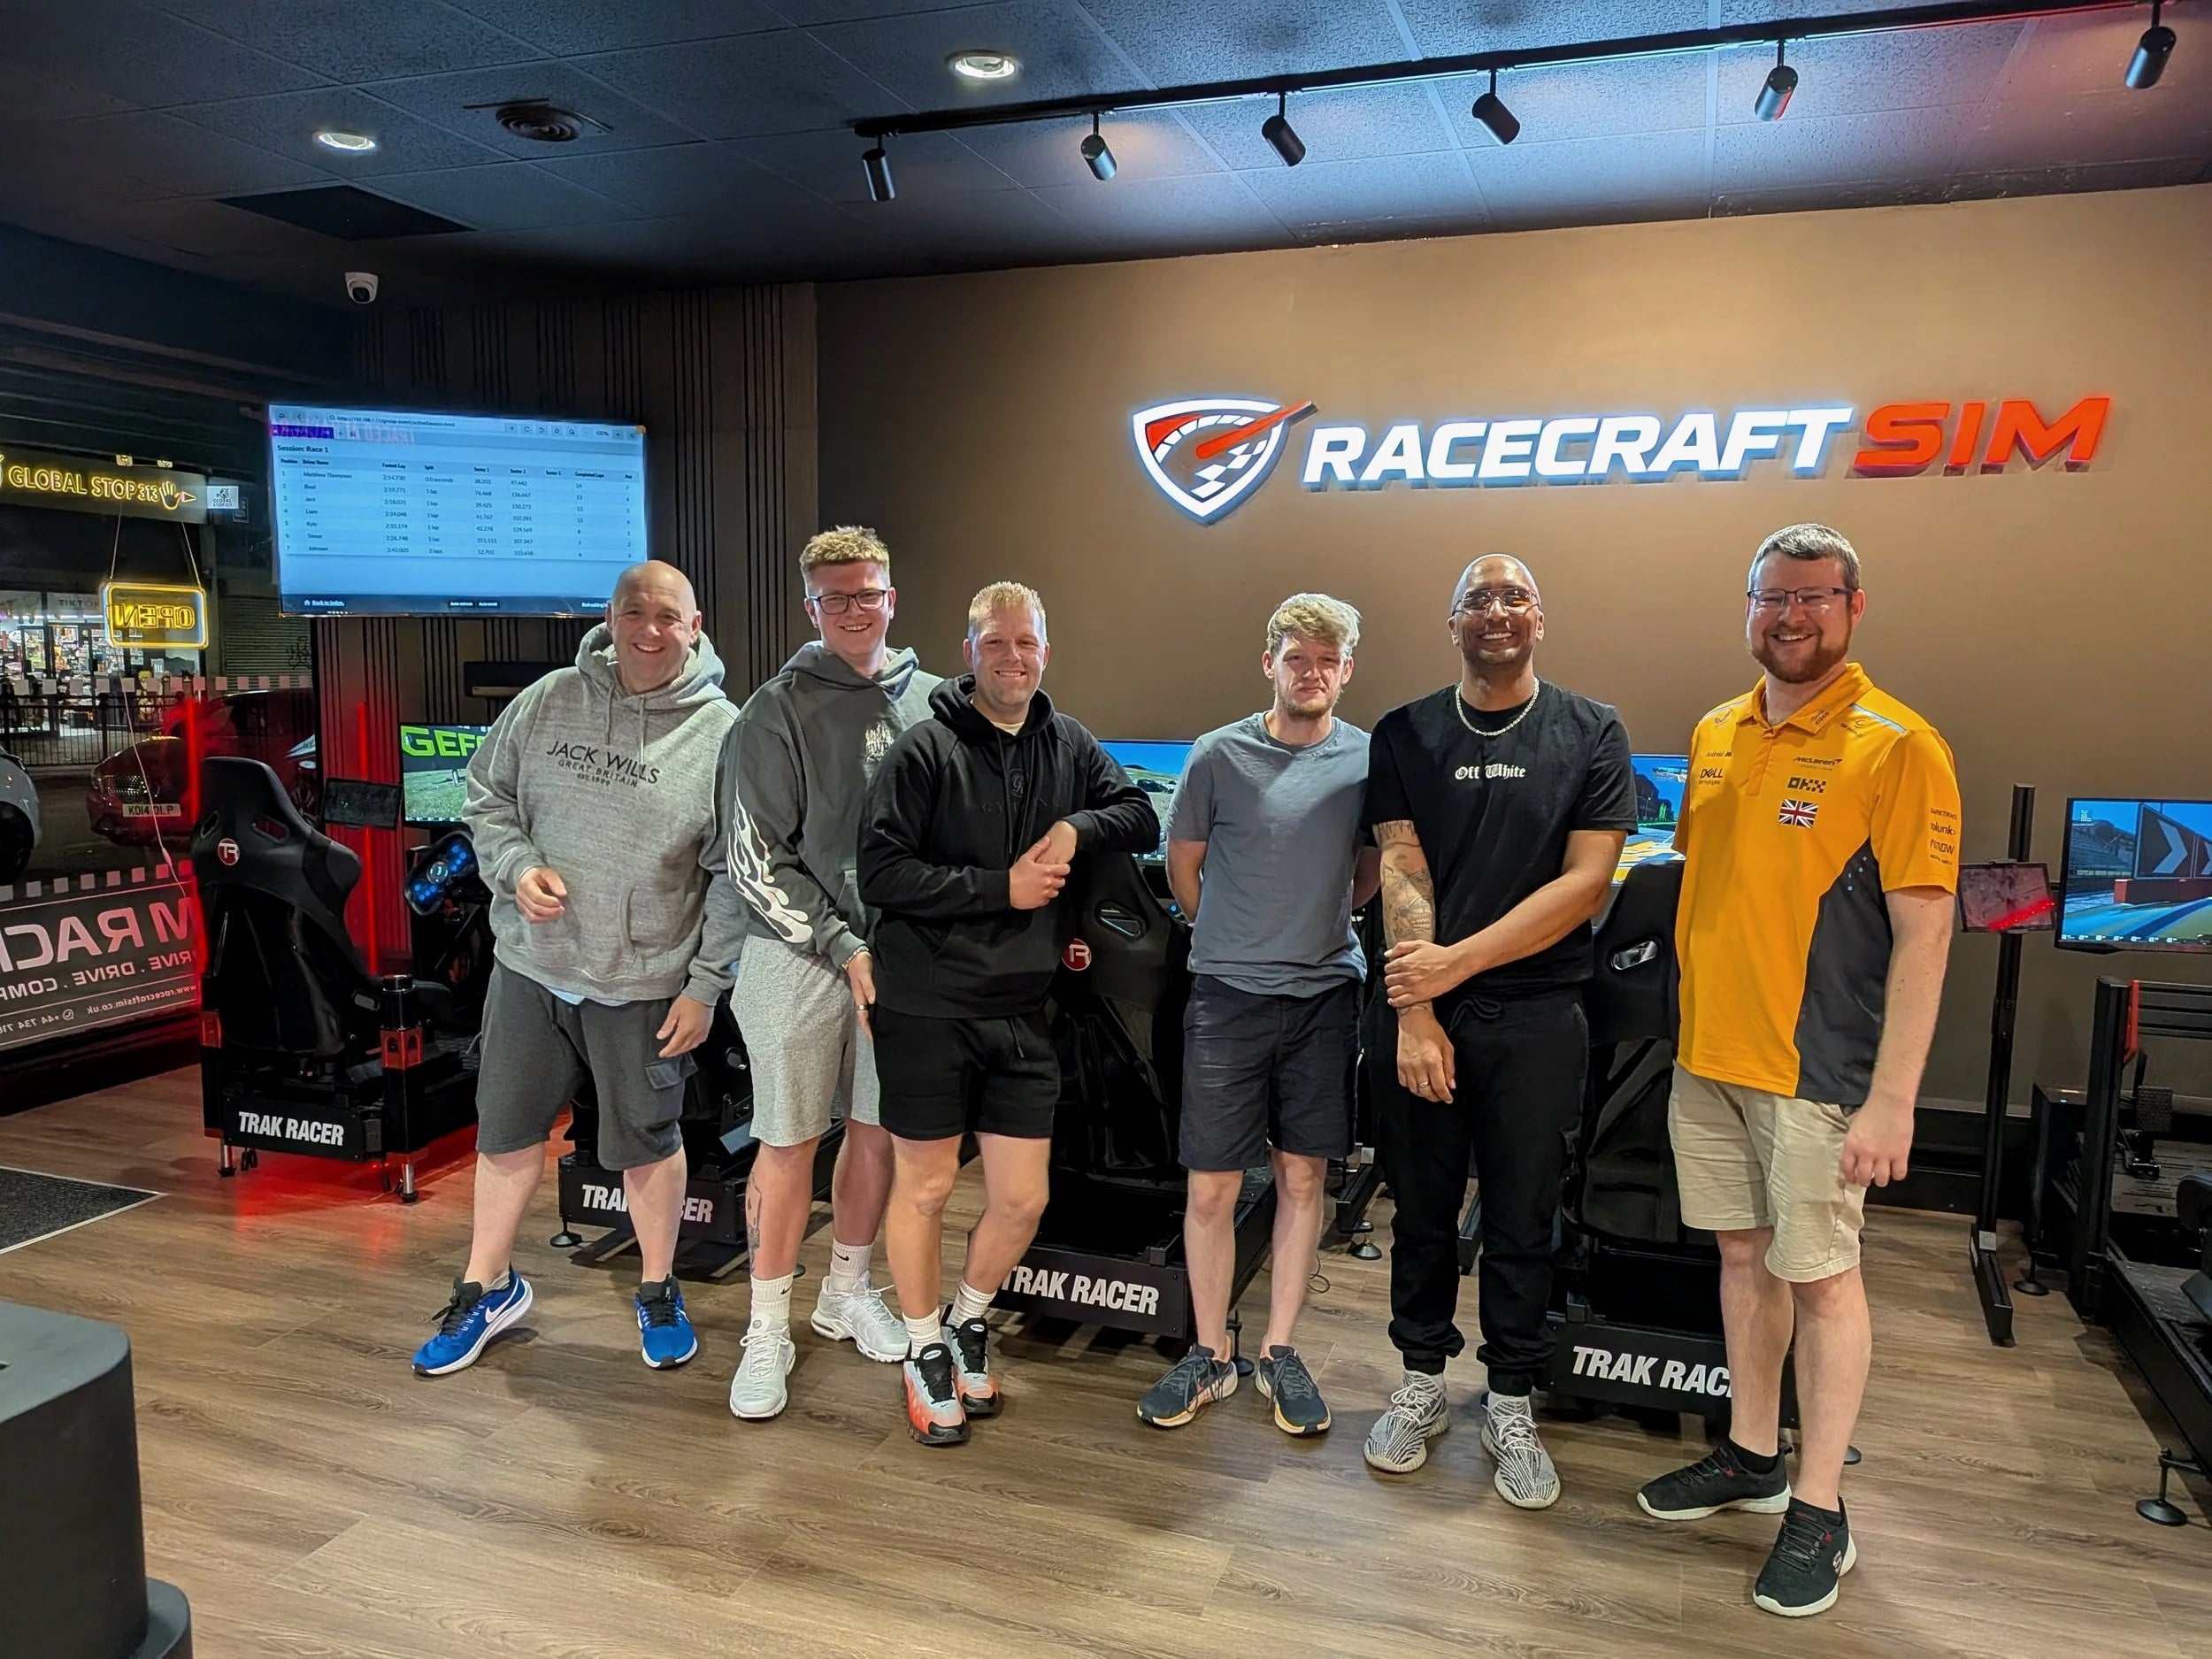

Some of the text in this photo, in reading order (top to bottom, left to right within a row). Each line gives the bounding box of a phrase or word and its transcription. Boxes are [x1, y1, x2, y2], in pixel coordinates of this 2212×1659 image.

[1302, 397, 2111, 483] RACECRAFT SIM
[9, 465, 88, 495] GLOBAL
[91, 475, 136, 501] STOP
[547, 741, 660, 784] JACK WILLS
[558, 759, 638, 788] GREAT BRITAIN
[1455, 763, 1526, 780] Off White
[1700, 768, 1723, 779] DELL
[1793, 757, 1836, 766] McLaren
[592, 775, 611, 786] 1999
[238, 1111, 344, 1146] TRAK RACER
[1002, 1265, 1159, 1315] TRAK RACER
[1572, 1345, 1732, 1398] TRAK RAC
